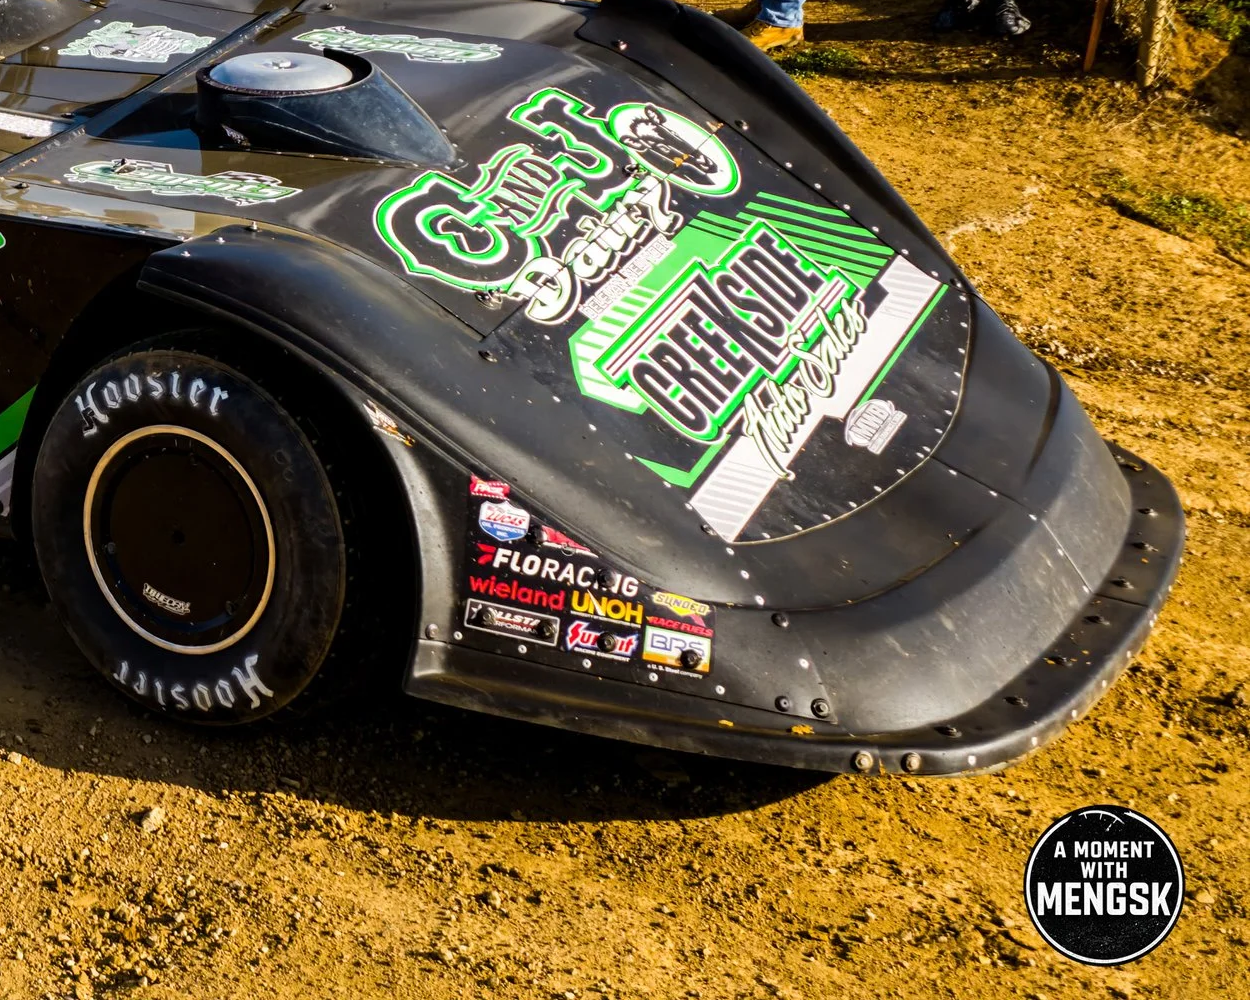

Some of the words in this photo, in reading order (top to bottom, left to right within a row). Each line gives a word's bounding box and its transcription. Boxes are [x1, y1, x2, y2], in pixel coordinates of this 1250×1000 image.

[487, 158, 563, 226] AND
[507, 174, 684, 324] Dairy
[631, 230, 827, 434] CREEKSIDE
[75, 370, 230, 437] Hoosier
[742, 377, 810, 481] Auto
[787, 296, 867, 399] Sales
[485, 510, 526, 526] LUCAS
[469, 575, 565, 610] wieland
[571, 590, 644, 625] UNOH
[650, 616, 681, 629] RACE
[681, 622, 714, 637] FUELS
[655, 592, 708, 615] SUNOCO
[113, 653, 275, 713] Hoosier
